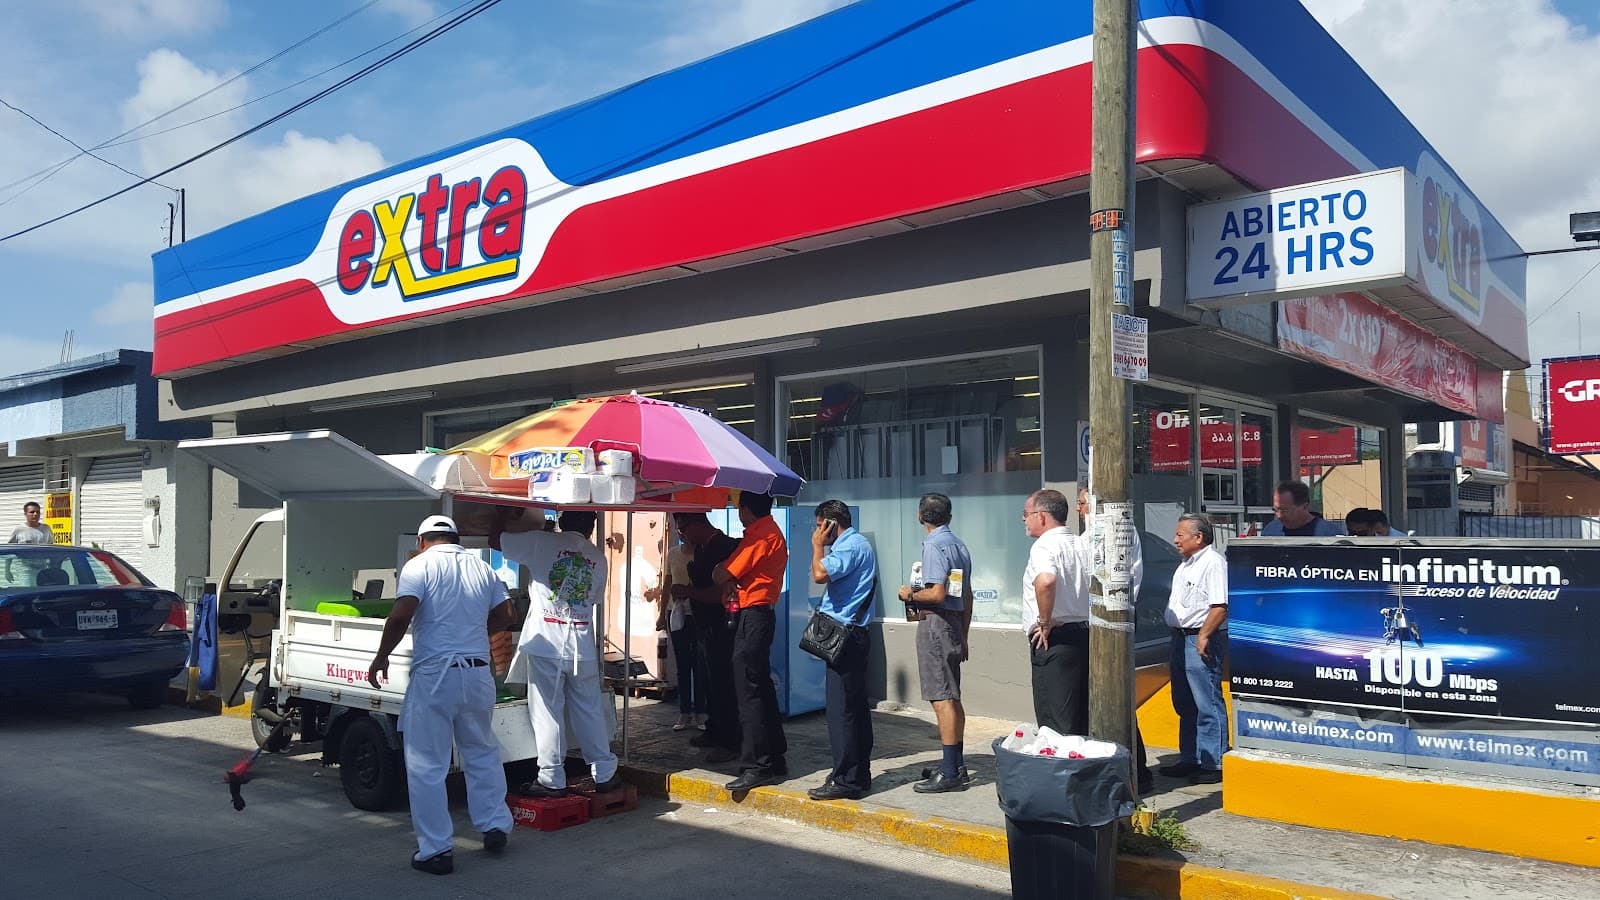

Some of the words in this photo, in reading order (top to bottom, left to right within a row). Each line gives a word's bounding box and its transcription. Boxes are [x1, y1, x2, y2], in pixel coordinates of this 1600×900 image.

[1220, 189, 1367, 241] ABIERTO
[337, 165, 528, 302] extra
[1423, 176, 1480, 312] extra
[1213, 242, 1271, 286] 24
[1287, 226, 1375, 275] HRS
[1255, 566, 1298, 578] FIBRA
[1300, 565, 1355, 580] ÓPTICA
[1358, 570, 1379, 581] EN
[1415, 585, 1464, 598] Exceso
[1467, 586, 1486, 598] de
[1489, 586, 1561, 601] Velocidad
[1232, 676, 1241, 684] 01
[1243, 677, 1258, 685] 800
[1259, 679, 1273, 687] 123
[1274, 680, 1294, 689] 2222
[1315, 666, 1358, 682] HASTA
[1363, 650, 1444, 687] 100
[1448, 673, 1498, 693] Mbps
[1364, 685, 1422, 699] Disponible
[1424, 690, 1439, 699] en
[1441, 691, 1466, 701] esta
[1469, 694, 1497, 703] zona
[1247, 718, 1394, 744] www.telmex.com
[1416, 735, 1588, 762] www.telmex.com
